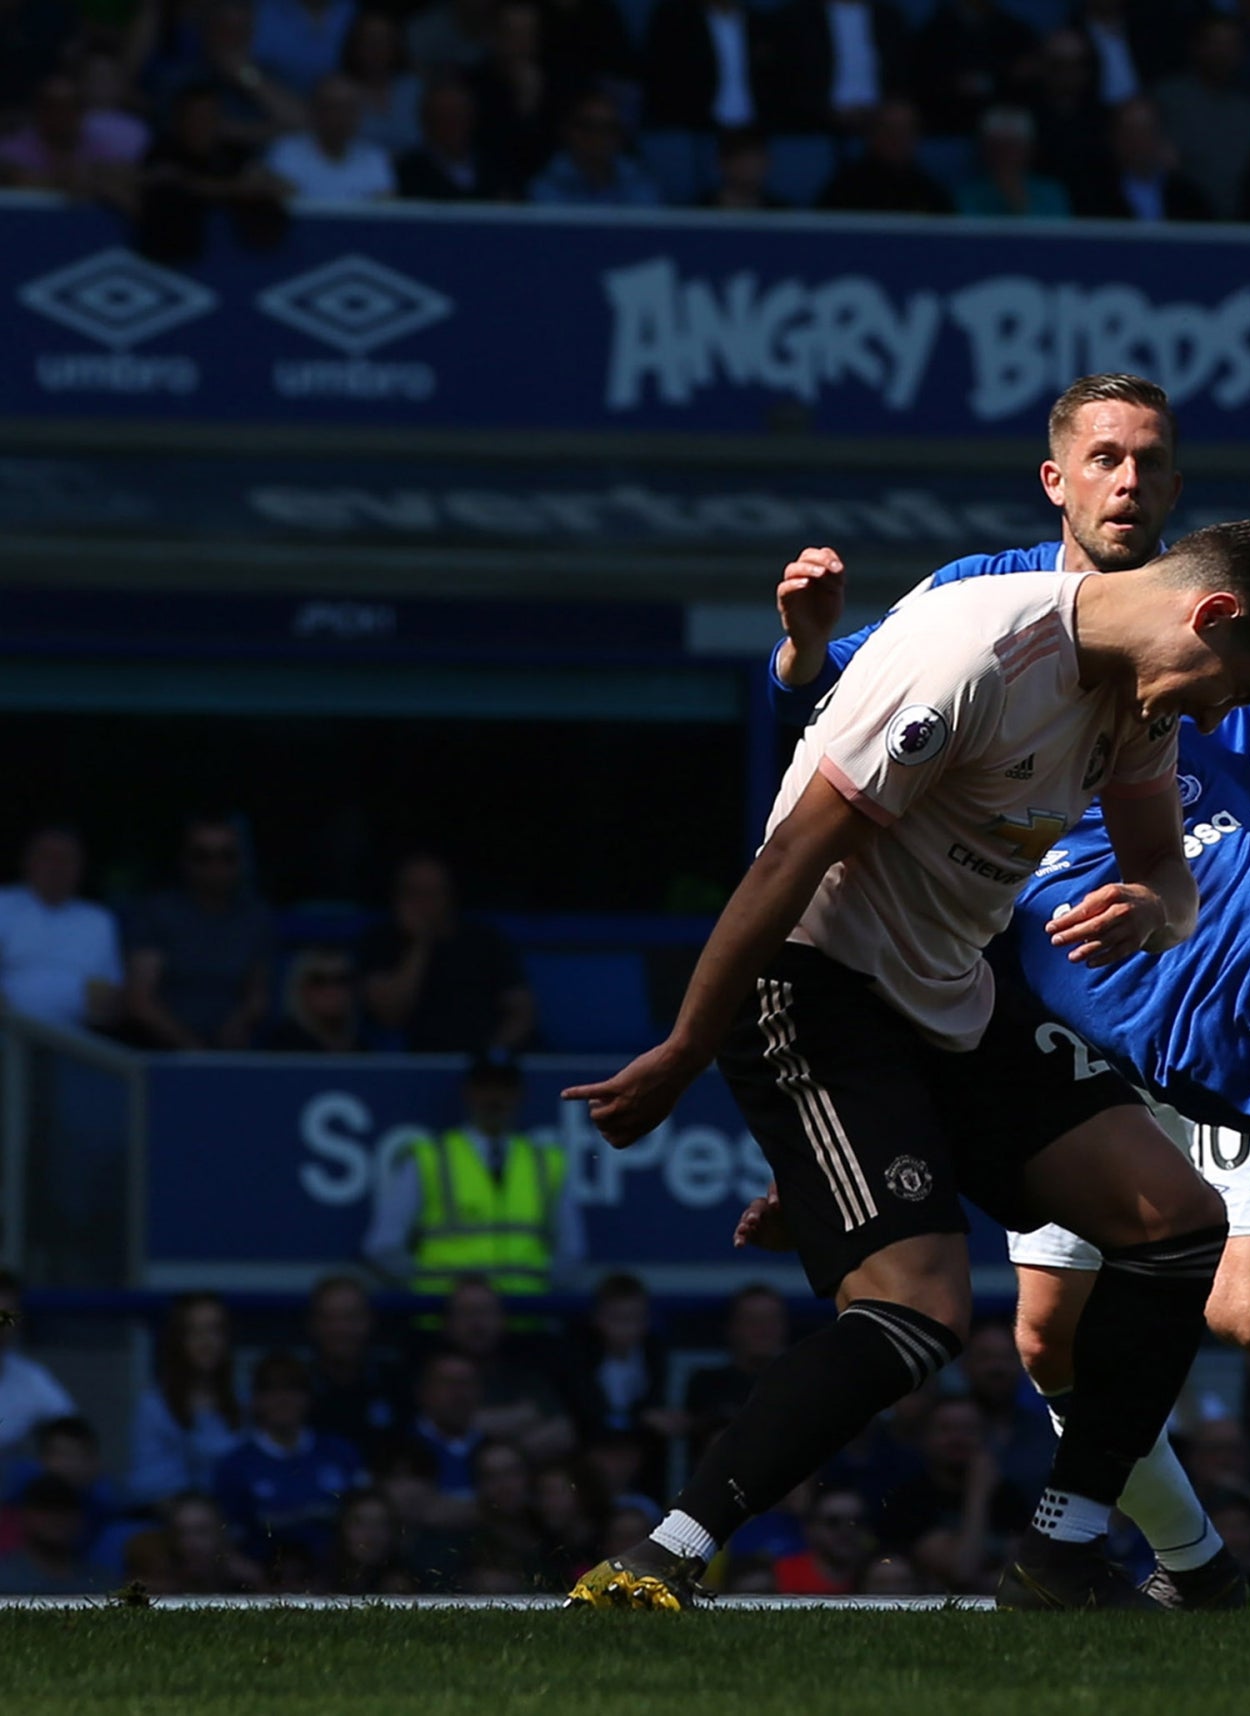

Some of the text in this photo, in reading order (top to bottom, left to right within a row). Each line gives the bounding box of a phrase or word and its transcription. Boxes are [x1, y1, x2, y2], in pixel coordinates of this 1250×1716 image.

[602, 256, 940, 413] ANGRY
[35, 352, 200, 394] umbro
[272, 357, 437, 401] umbro
[1035, 861, 1071, 877] umbro
